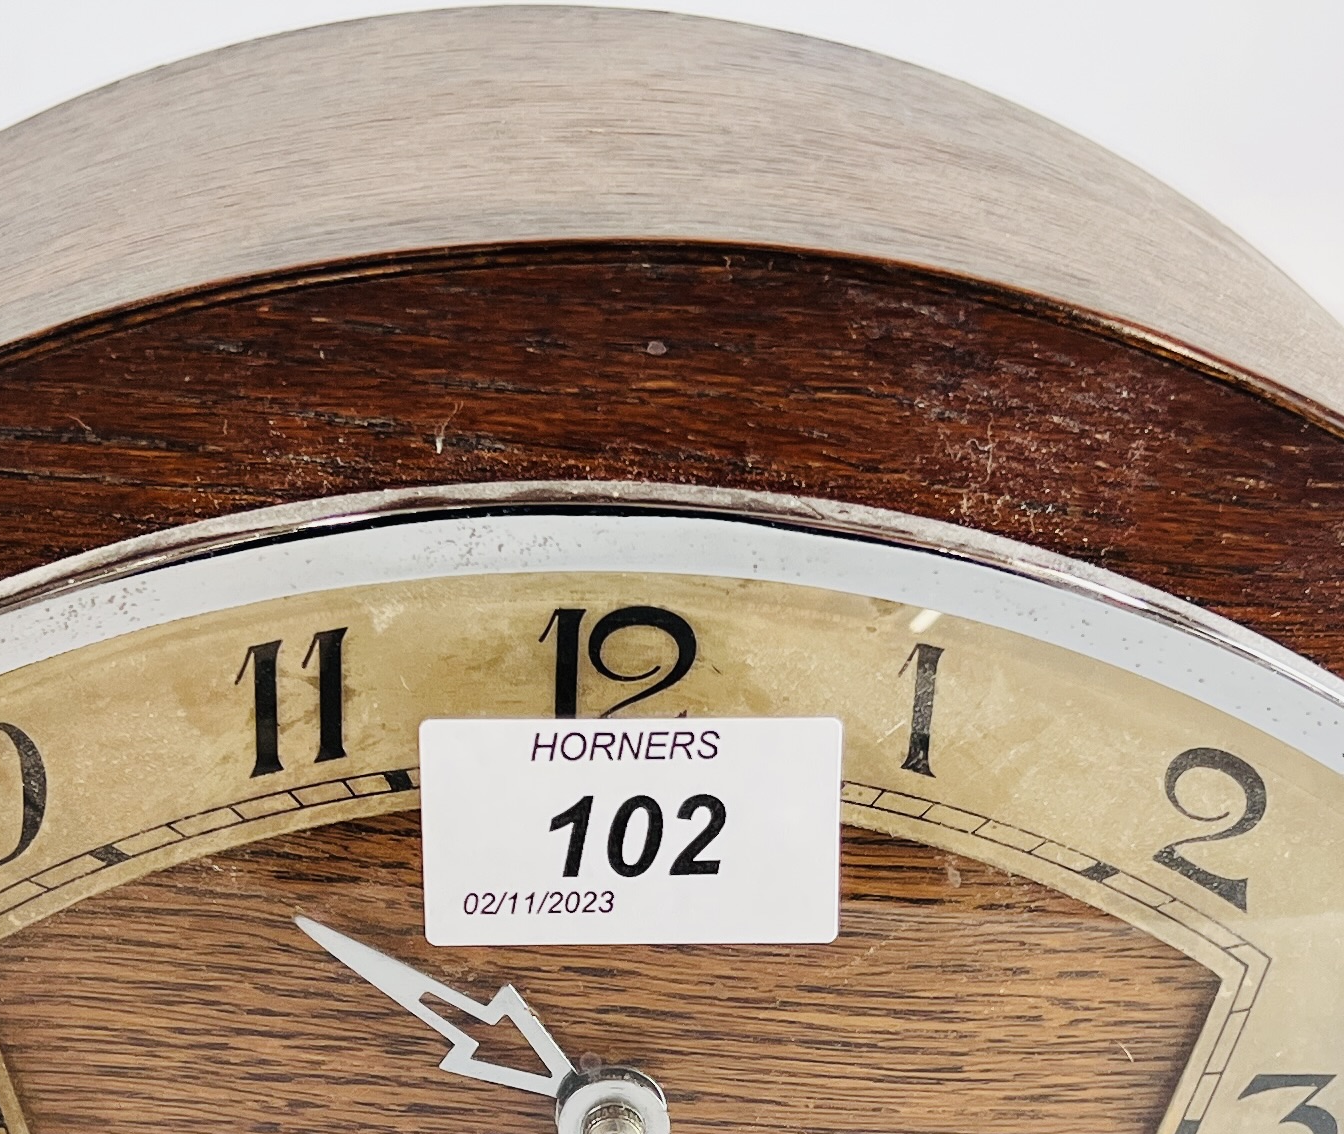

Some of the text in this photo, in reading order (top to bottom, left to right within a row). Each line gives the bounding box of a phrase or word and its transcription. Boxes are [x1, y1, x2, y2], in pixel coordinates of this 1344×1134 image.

[235, 627, 348, 777] 11
[538, 605, 697, 718] 12
[898, 643, 944, 778] 1
[531, 730, 721, 761] HORNERS
[549, 793, 727, 878] 102
[1152, 747, 1267, 913] 2
[463, 890, 615, 915] 02/11/2023
